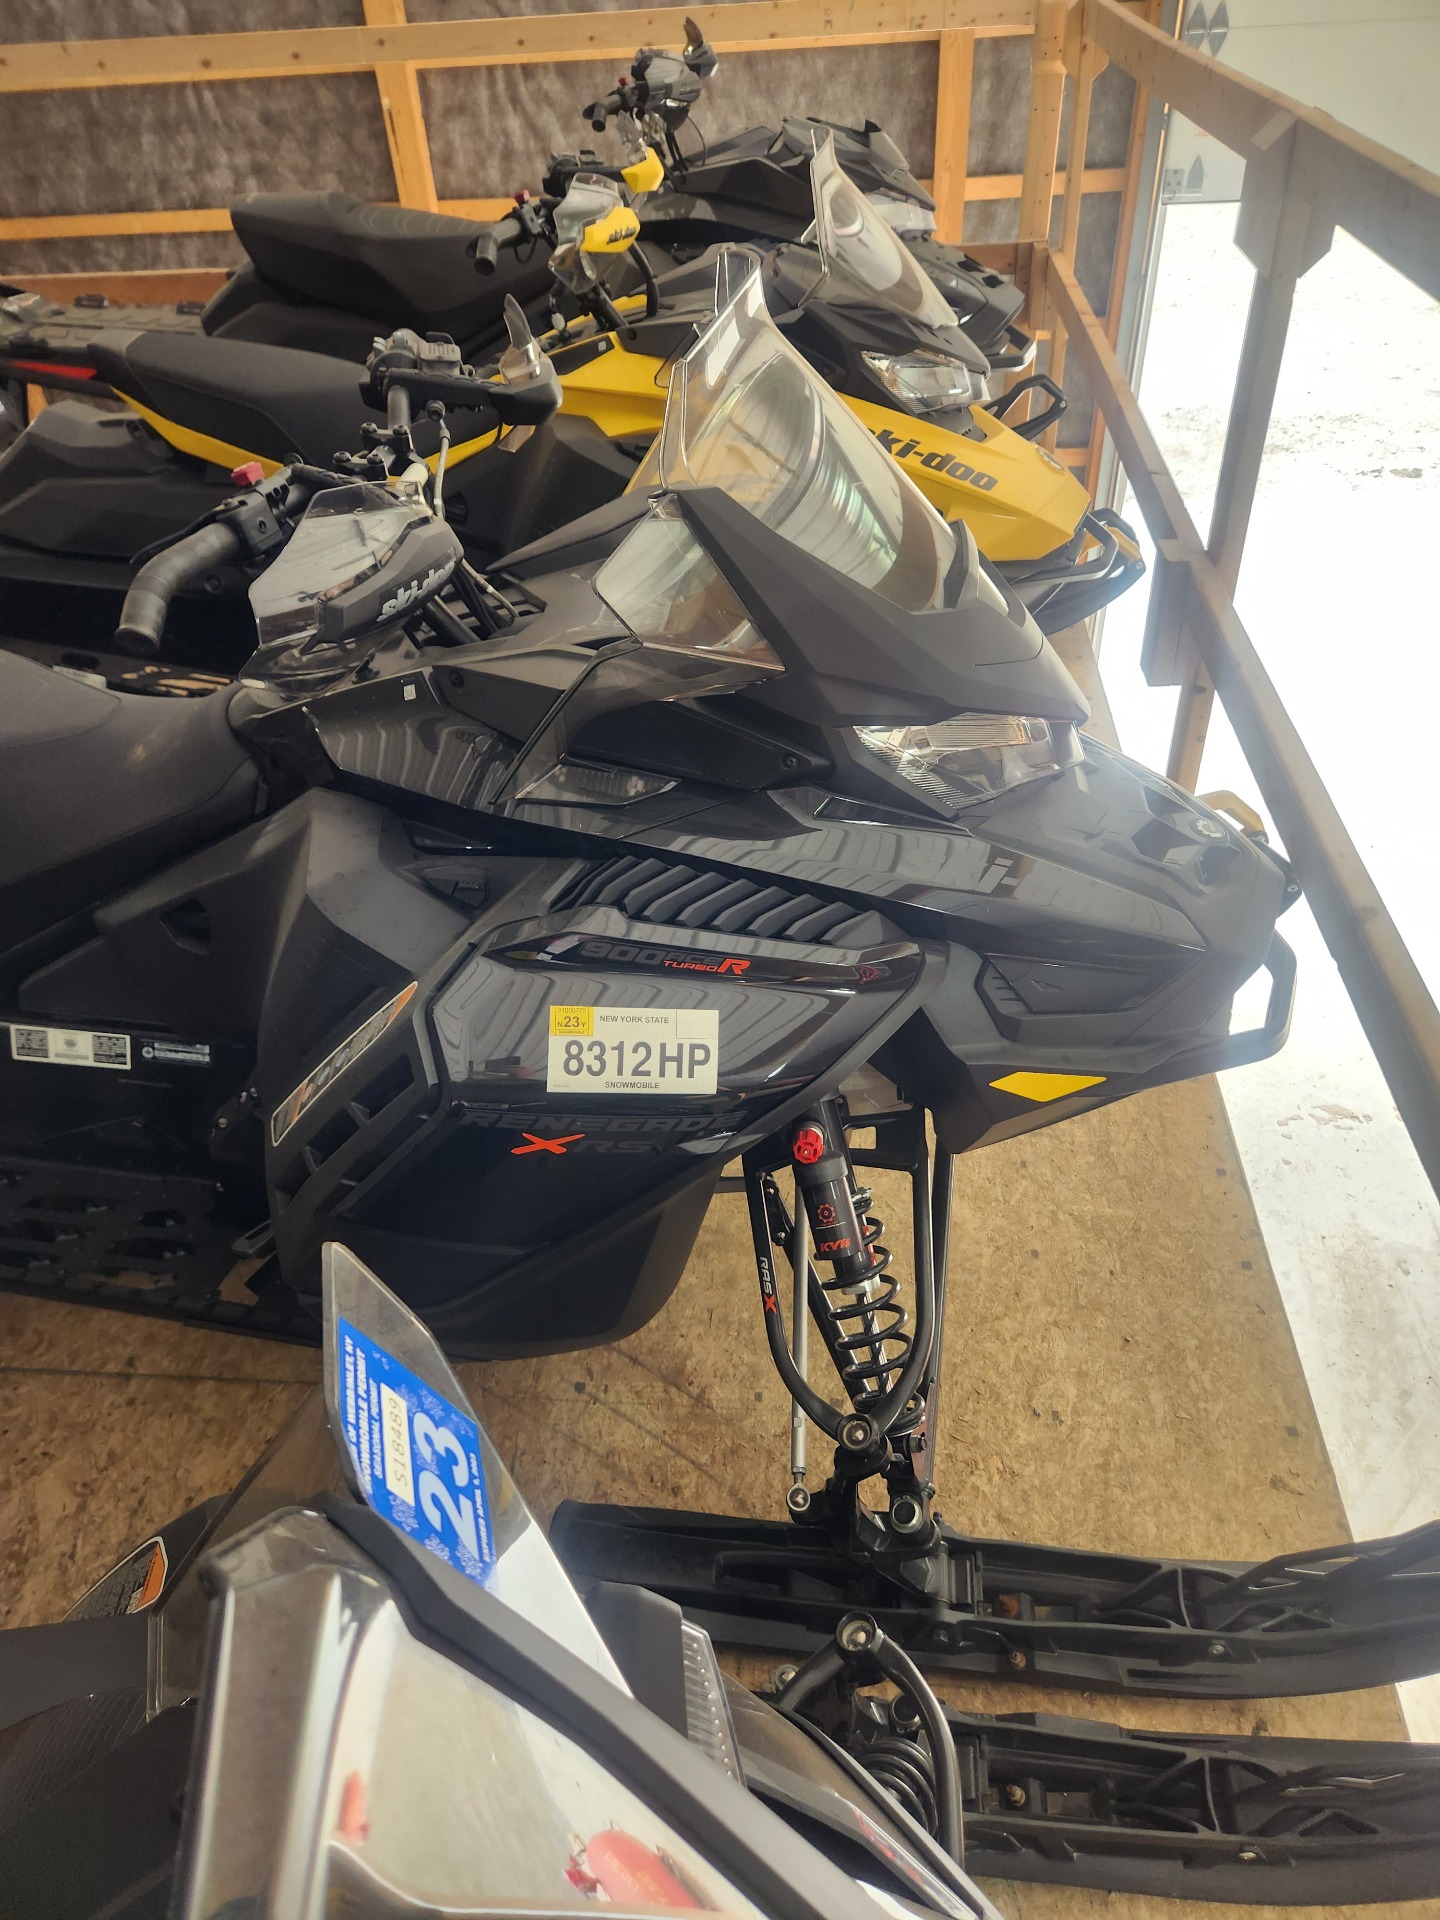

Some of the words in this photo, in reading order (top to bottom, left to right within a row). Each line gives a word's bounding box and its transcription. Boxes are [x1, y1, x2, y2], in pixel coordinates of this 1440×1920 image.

[867, 427, 999, 492] ki-doo
[581, 941, 667, 965] 900
[663, 960, 719, 972] TURBO
[563, 1015, 580, 1027] 23
[600, 1015, 619, 1023] NEW
[620, 1016, 643, 1024] YORK
[644, 1016, 670, 1024] STATE
[563, 1039, 711, 1079] 8312HP
[604, 1081, 661, 1090] SNOWMOBILE
[458, 1107, 748, 1134] RENEGADE
[820, 1238, 851, 1252] KYB
[344, 1334, 354, 1354] NY
[355, 1347, 368, 1399] PERMIT
[368, 1377, 380, 1420] PERMIT
[370, 1420, 384, 1479] SEASONAL
[388, 1397, 408, 1487] S18489
[412, 1411, 481, 1562] 23
[474, 1489, 485, 1518] APRIL
[477, 1518, 492, 1563] EXPIRES
